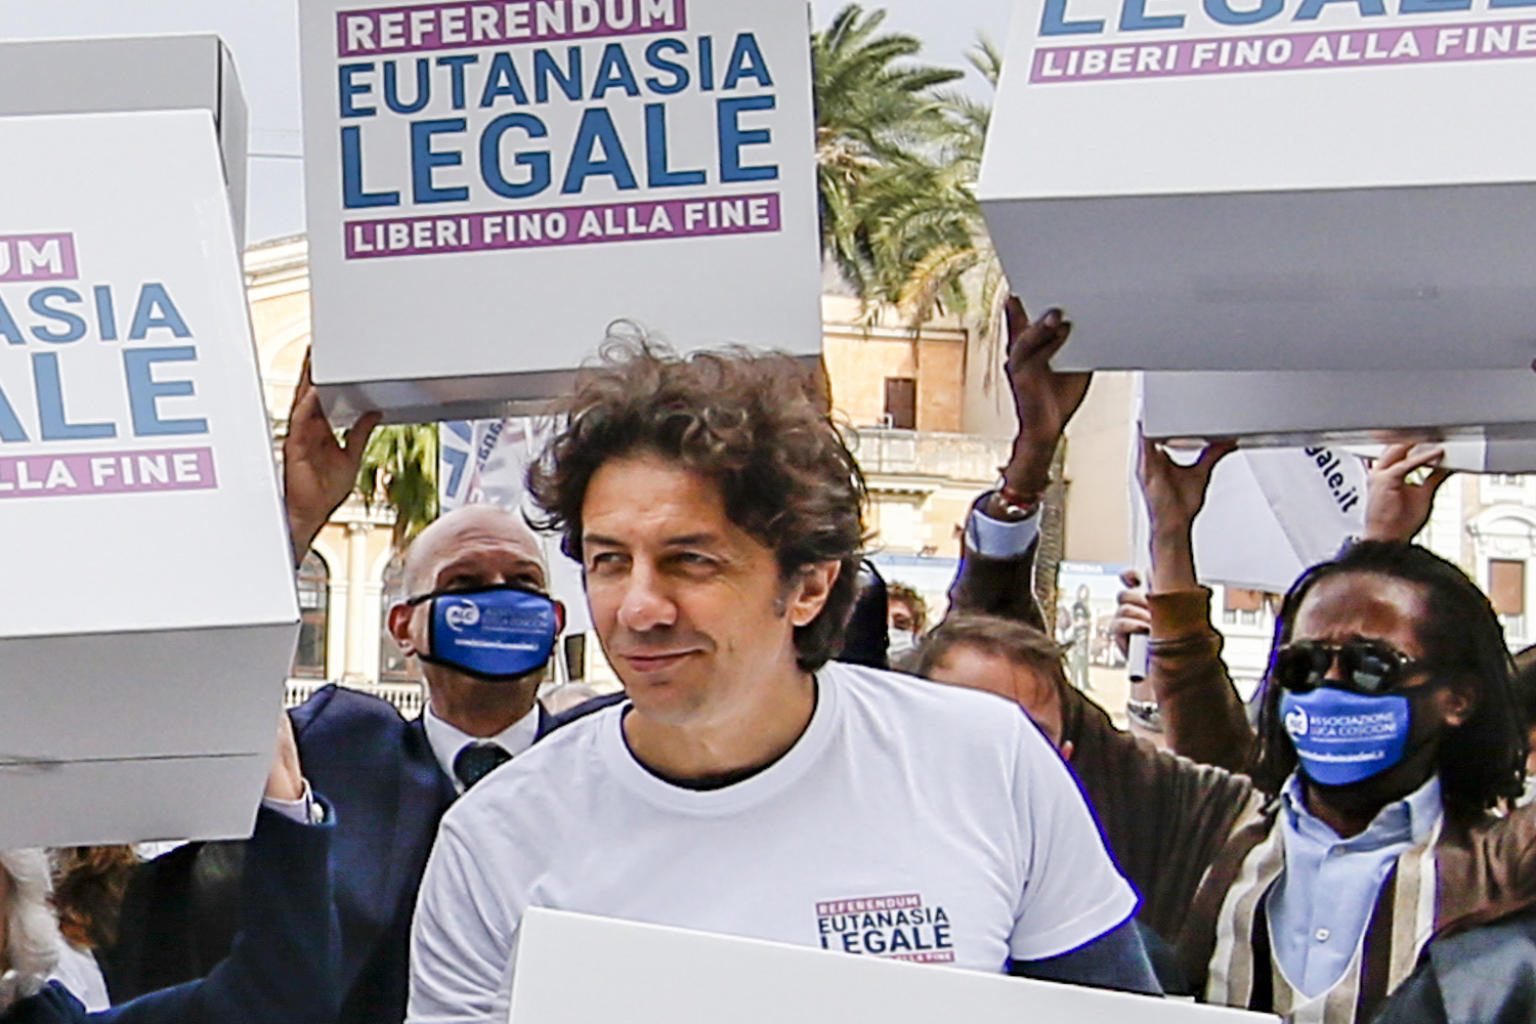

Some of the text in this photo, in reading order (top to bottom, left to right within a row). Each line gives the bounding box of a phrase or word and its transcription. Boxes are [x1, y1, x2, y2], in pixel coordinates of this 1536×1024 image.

[346, 0, 676, 51] REFERENDUM
[338, 32, 774, 119] EUTANASIA
[1041, 44, 1178, 78] LIBERI
[1191, 38, 1293, 69] FINO
[1305, 31, 1420, 62] ALLA
[340, 94, 779, 209] LEGALE
[353, 199, 769, 252] LIBERI FINO ALLA FINE
[91, 453, 202, 488] FINE
[817, 906, 950, 934] EUTANASIA
[819, 895, 919, 915] REFERENDUM
